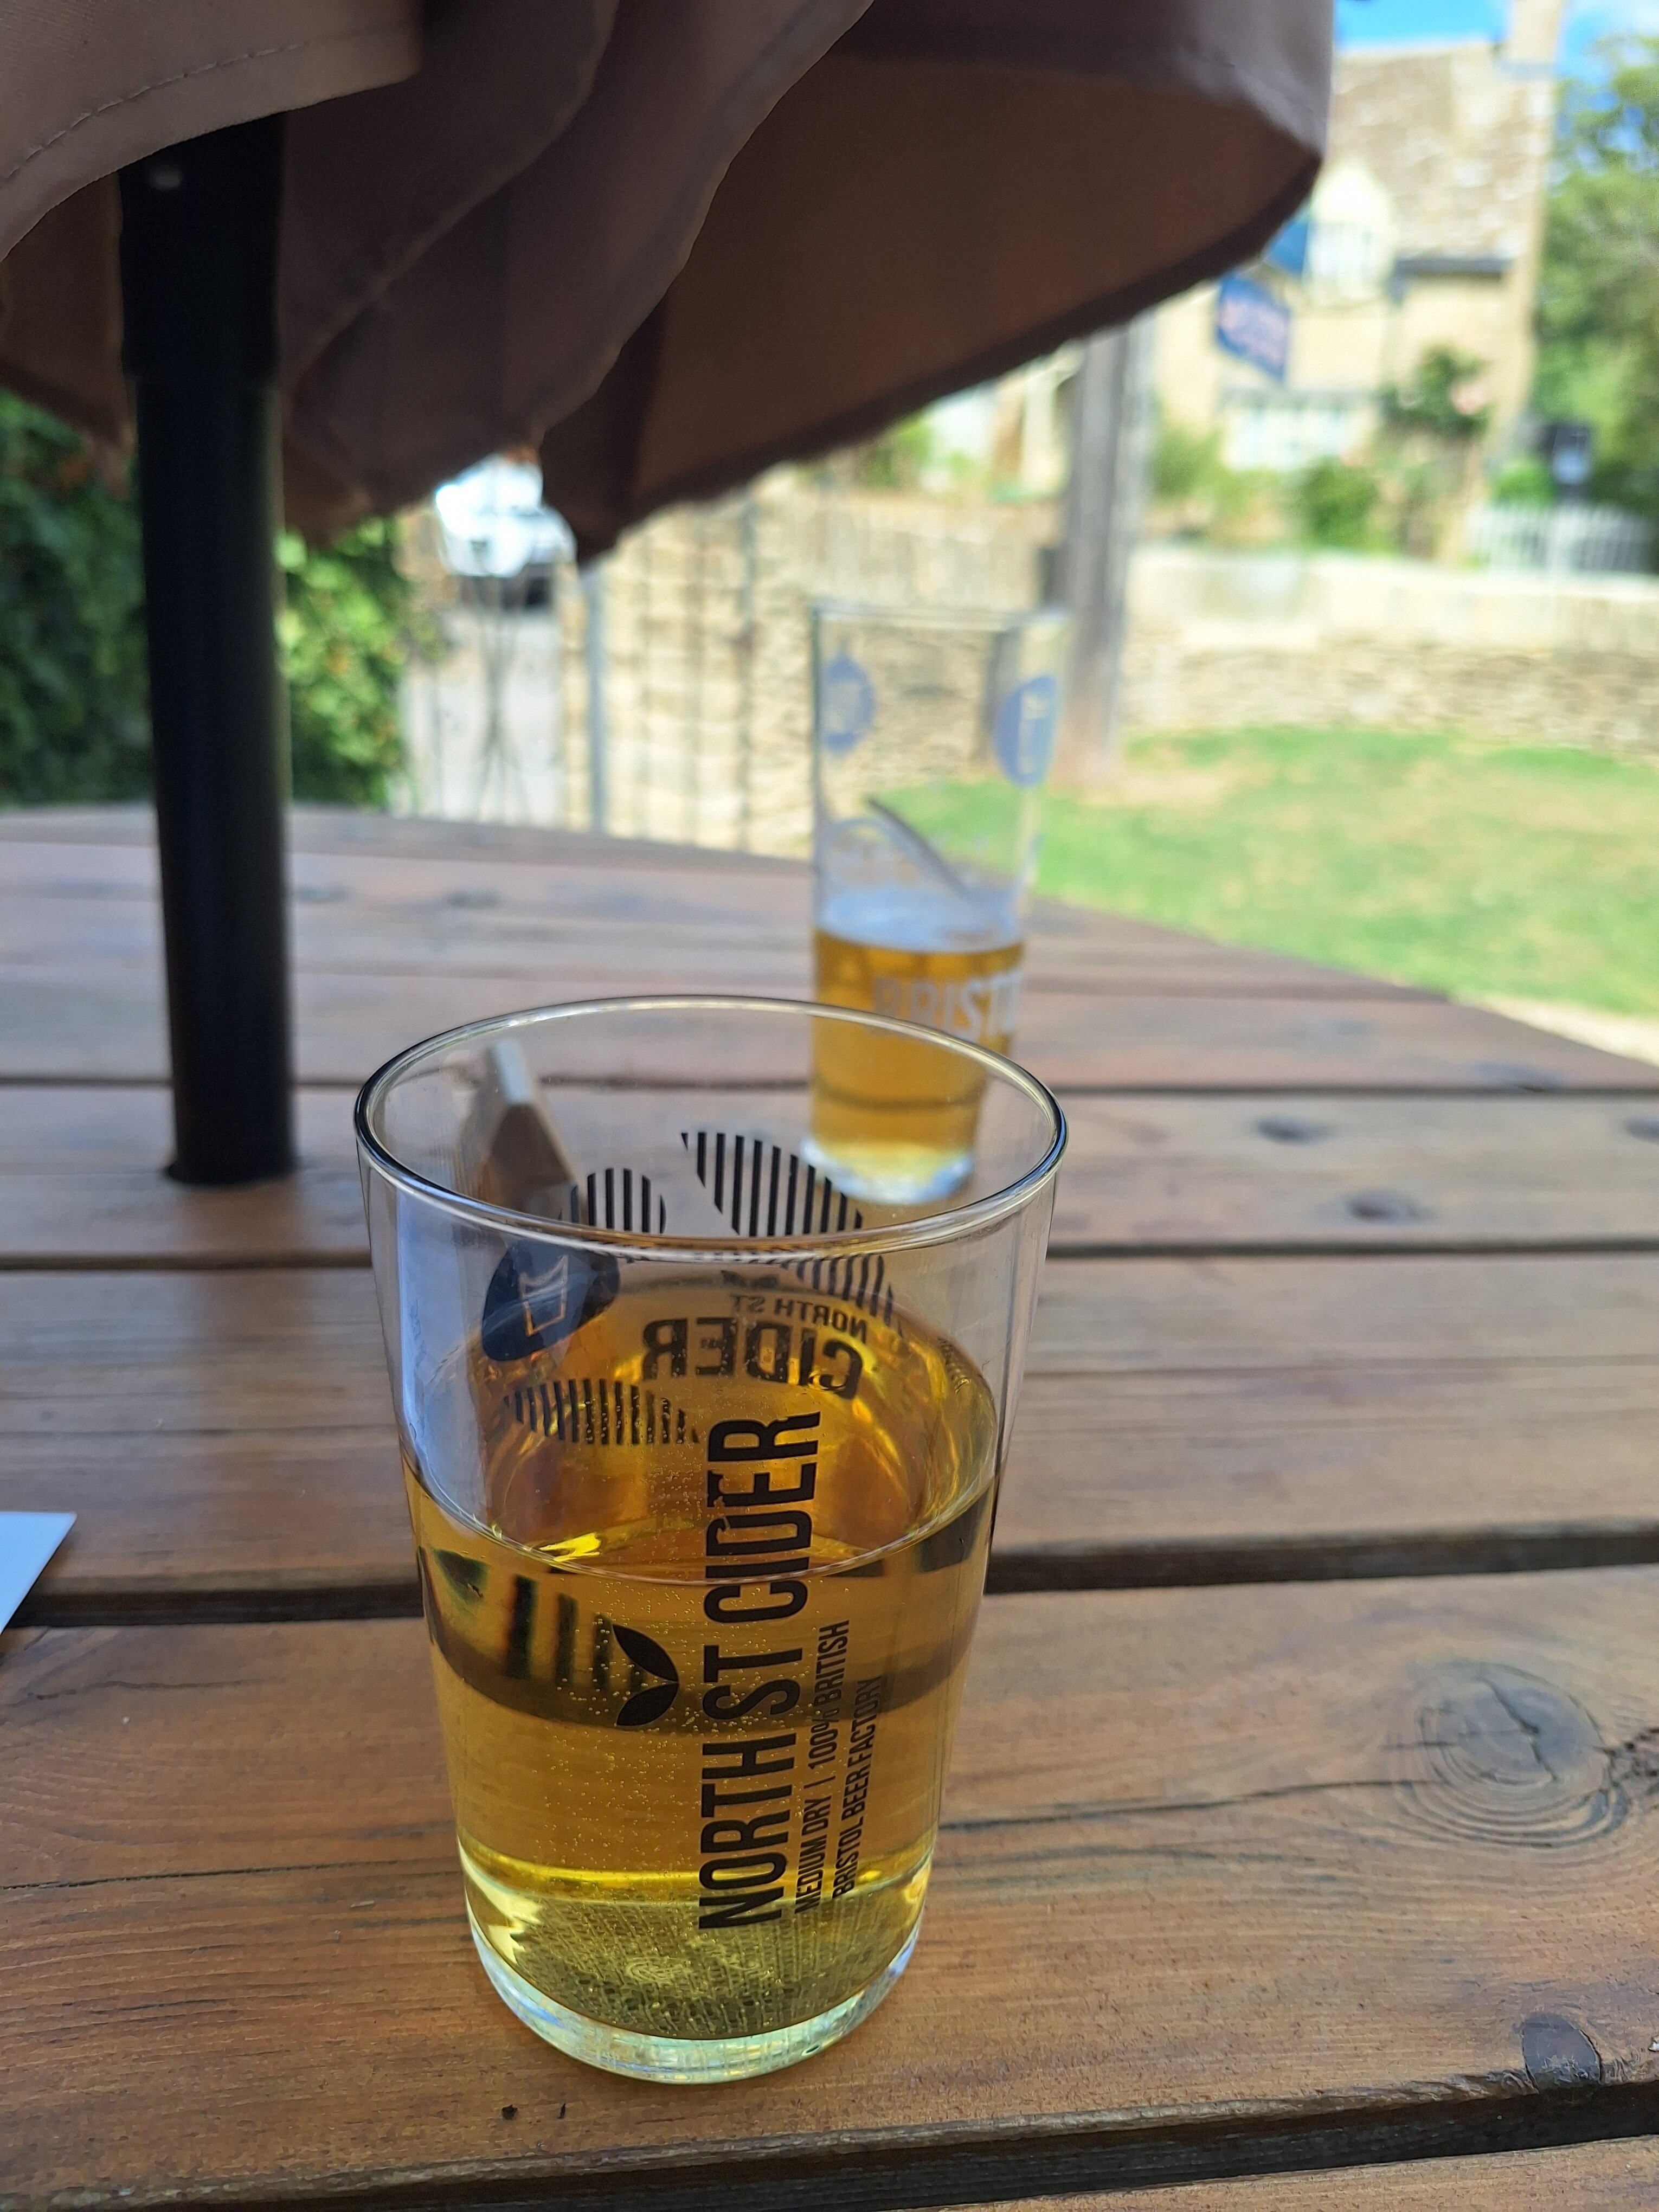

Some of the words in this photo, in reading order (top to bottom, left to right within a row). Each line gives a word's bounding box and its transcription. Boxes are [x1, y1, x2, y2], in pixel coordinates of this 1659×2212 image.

[704, 1411, 821, 1623] CIDER
[702, 1645, 802, 1720] ST
[814, 1619, 850, 1707] BRITISH
[808, 1707, 840, 1770] 100%
[847, 1675, 882, 1769] FACTORY
[698, 1732, 796, 1930] NORTH
[801, 1795, 832, 1836] DRY
[841, 1763, 871, 1821] BEER
[794, 1834, 827, 1914] MEDIUM
[832, 1816, 864, 1899] BRISTOL
